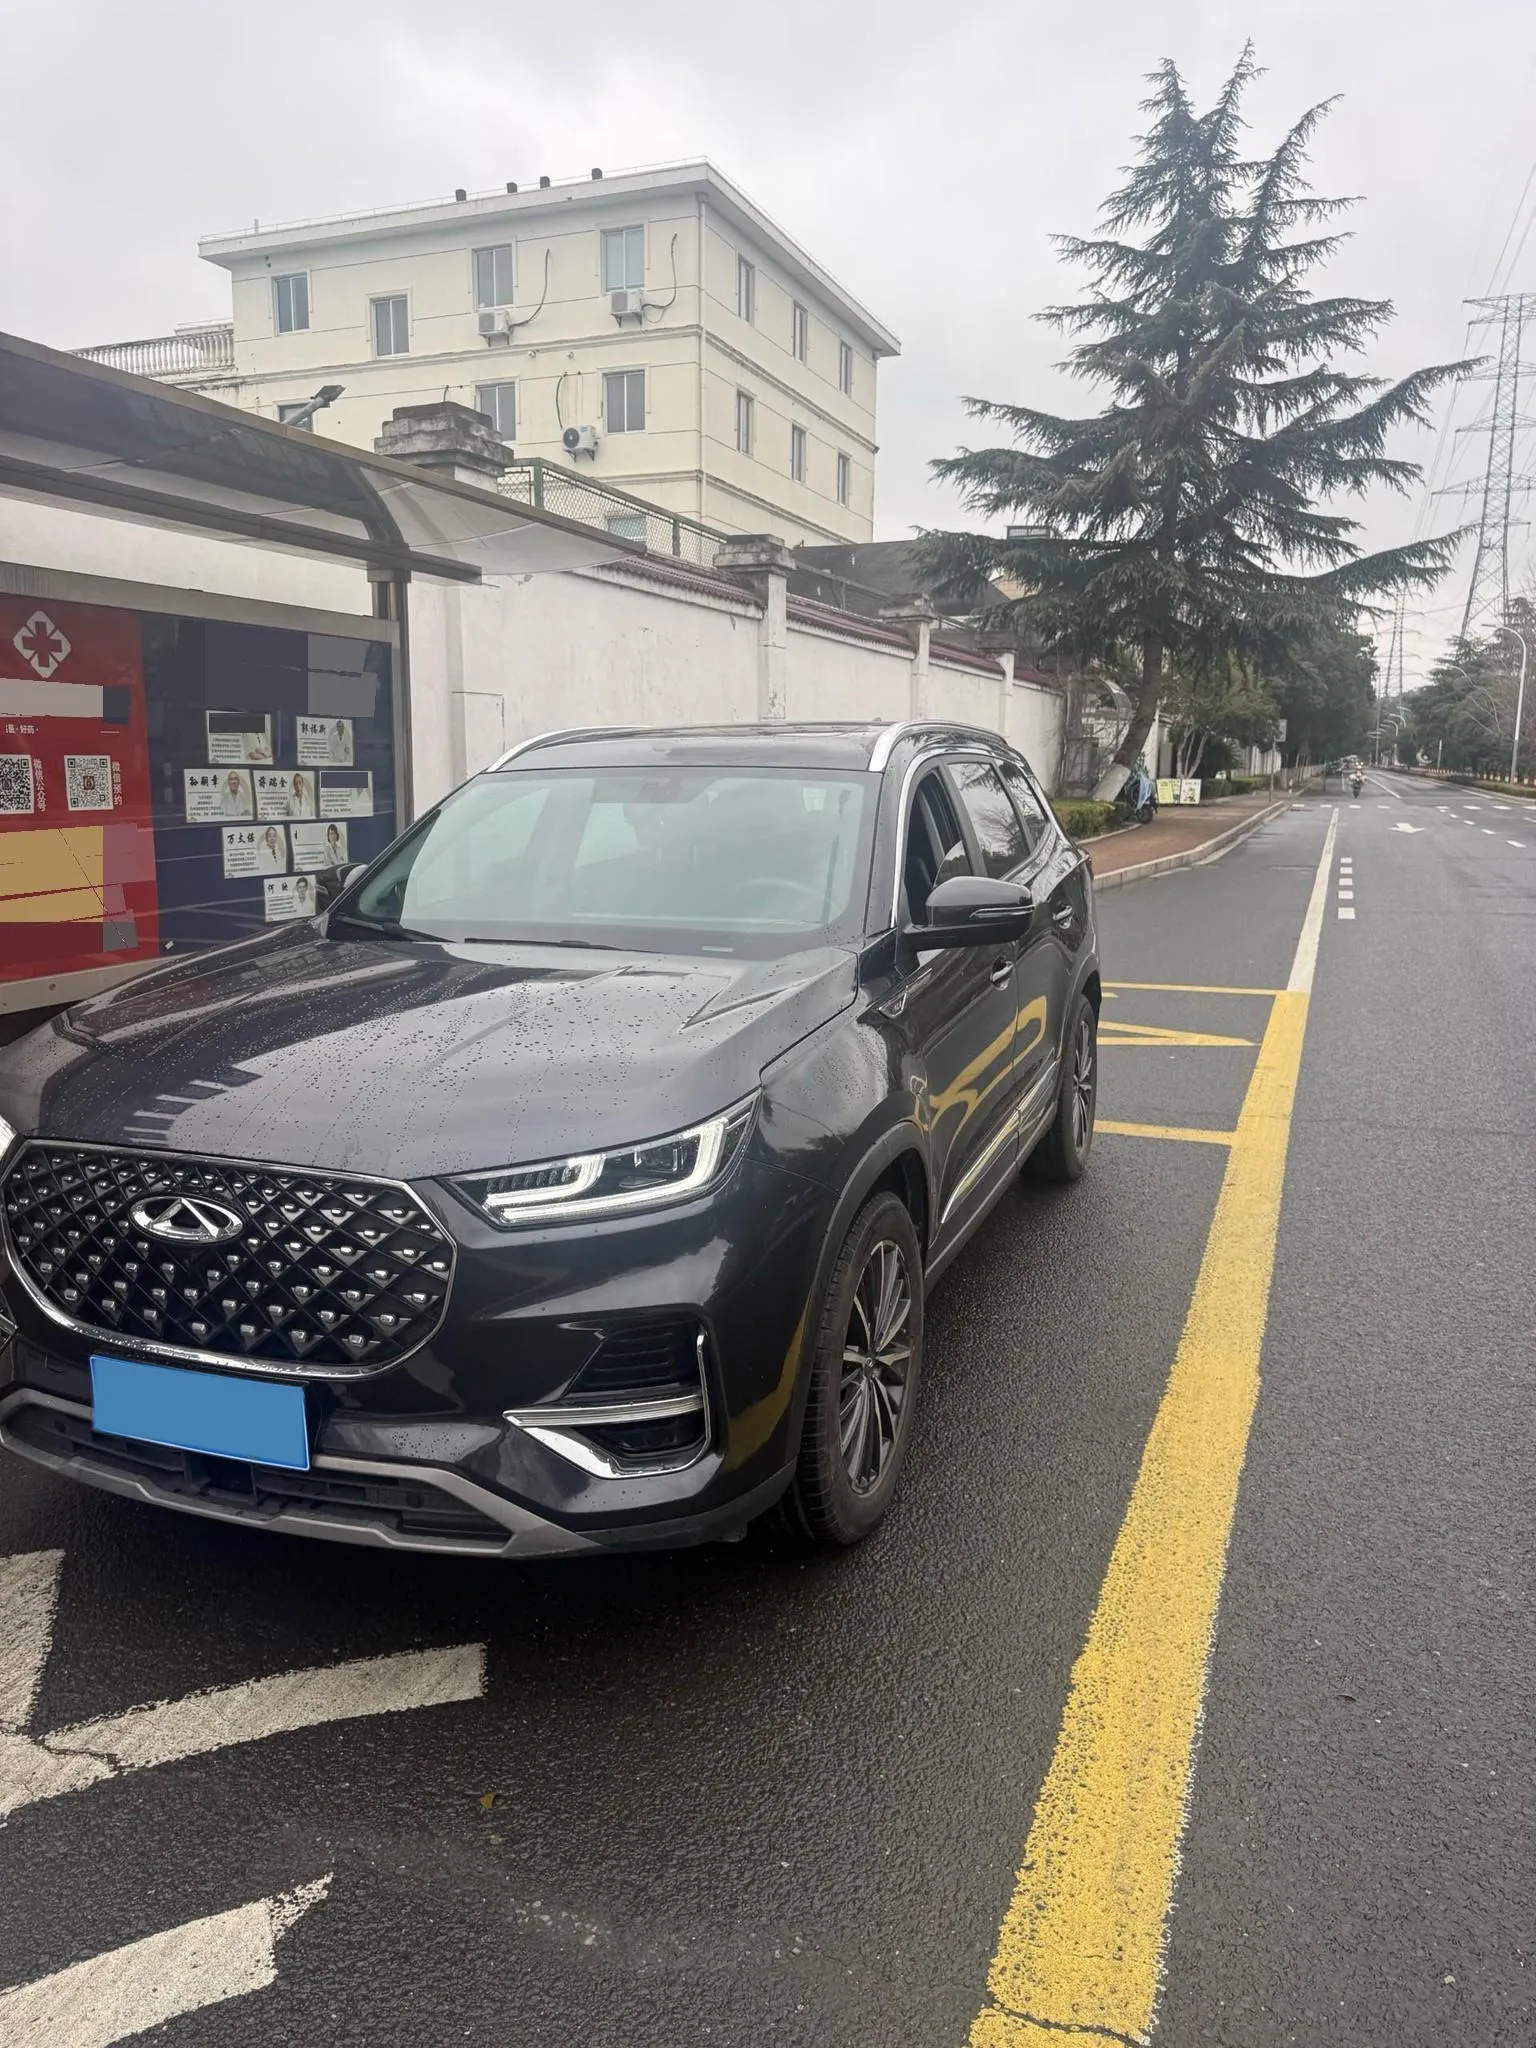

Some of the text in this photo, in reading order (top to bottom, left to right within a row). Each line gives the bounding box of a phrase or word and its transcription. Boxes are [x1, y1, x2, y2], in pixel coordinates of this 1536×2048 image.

[33, 758, 46, 812] 微信公众号
[111, 761, 122, 806] 微信预约
